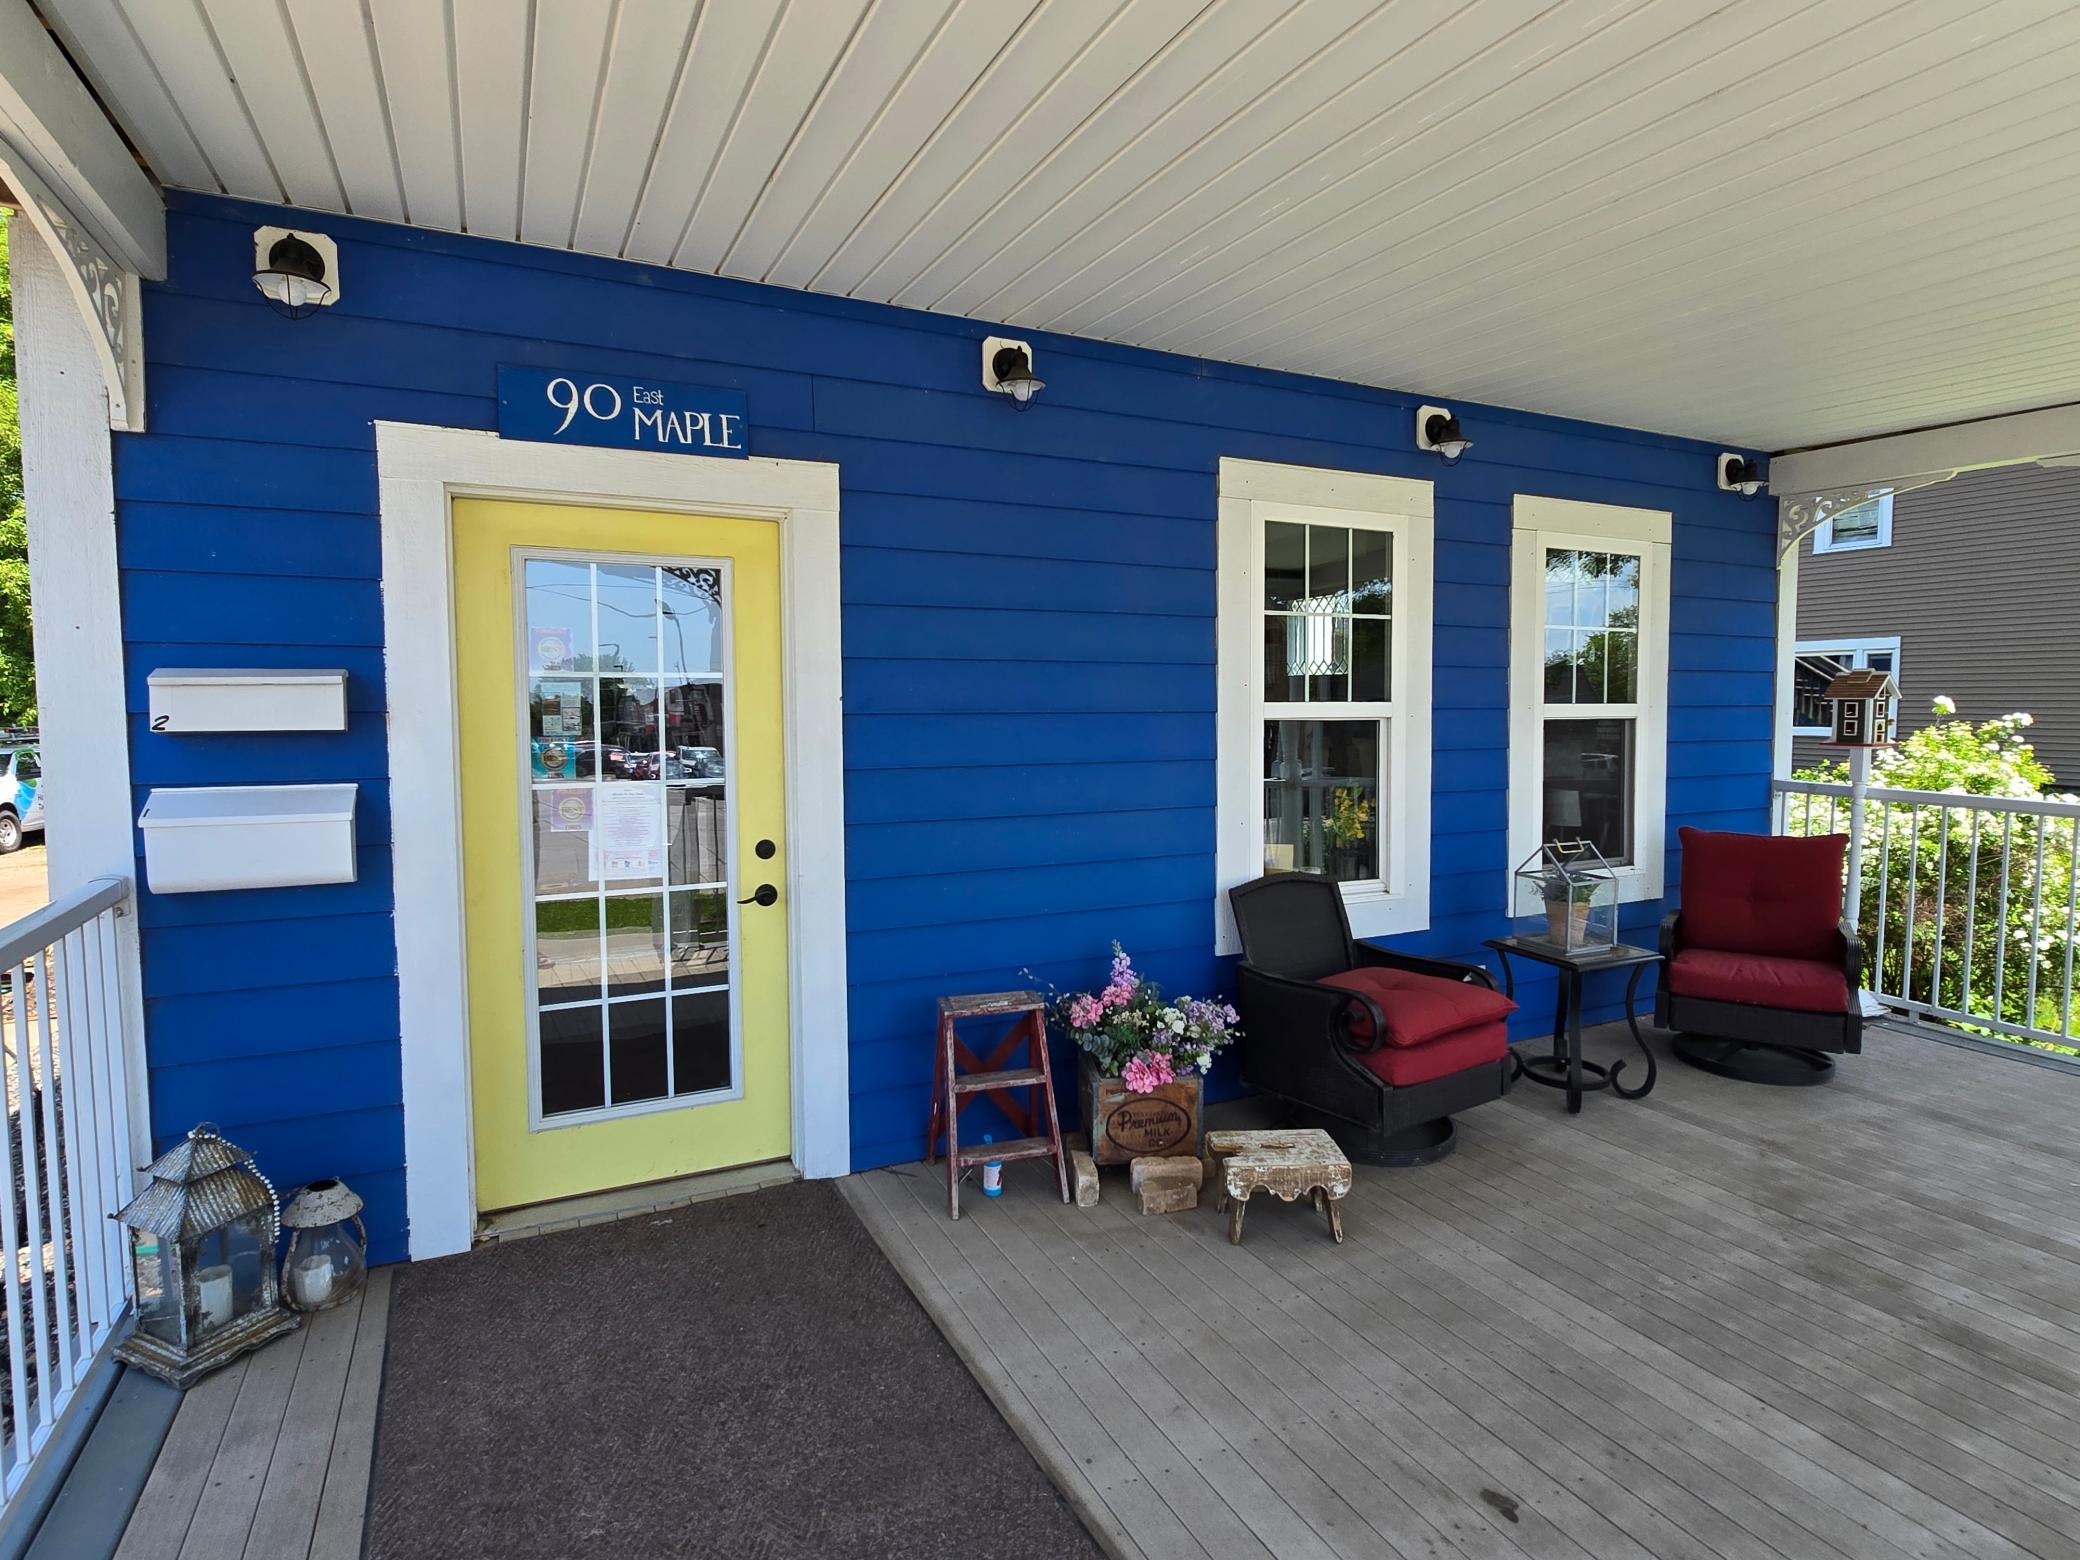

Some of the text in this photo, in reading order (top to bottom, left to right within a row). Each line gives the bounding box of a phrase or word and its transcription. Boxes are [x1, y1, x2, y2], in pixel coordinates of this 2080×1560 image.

[546, 377, 622, 435] 90
[632, 386, 664, 406] East
[632, 406, 742, 449] MAPLE
[151, 715, 170, 731] 2
[1143, 1127, 1171, 1138] MILK
